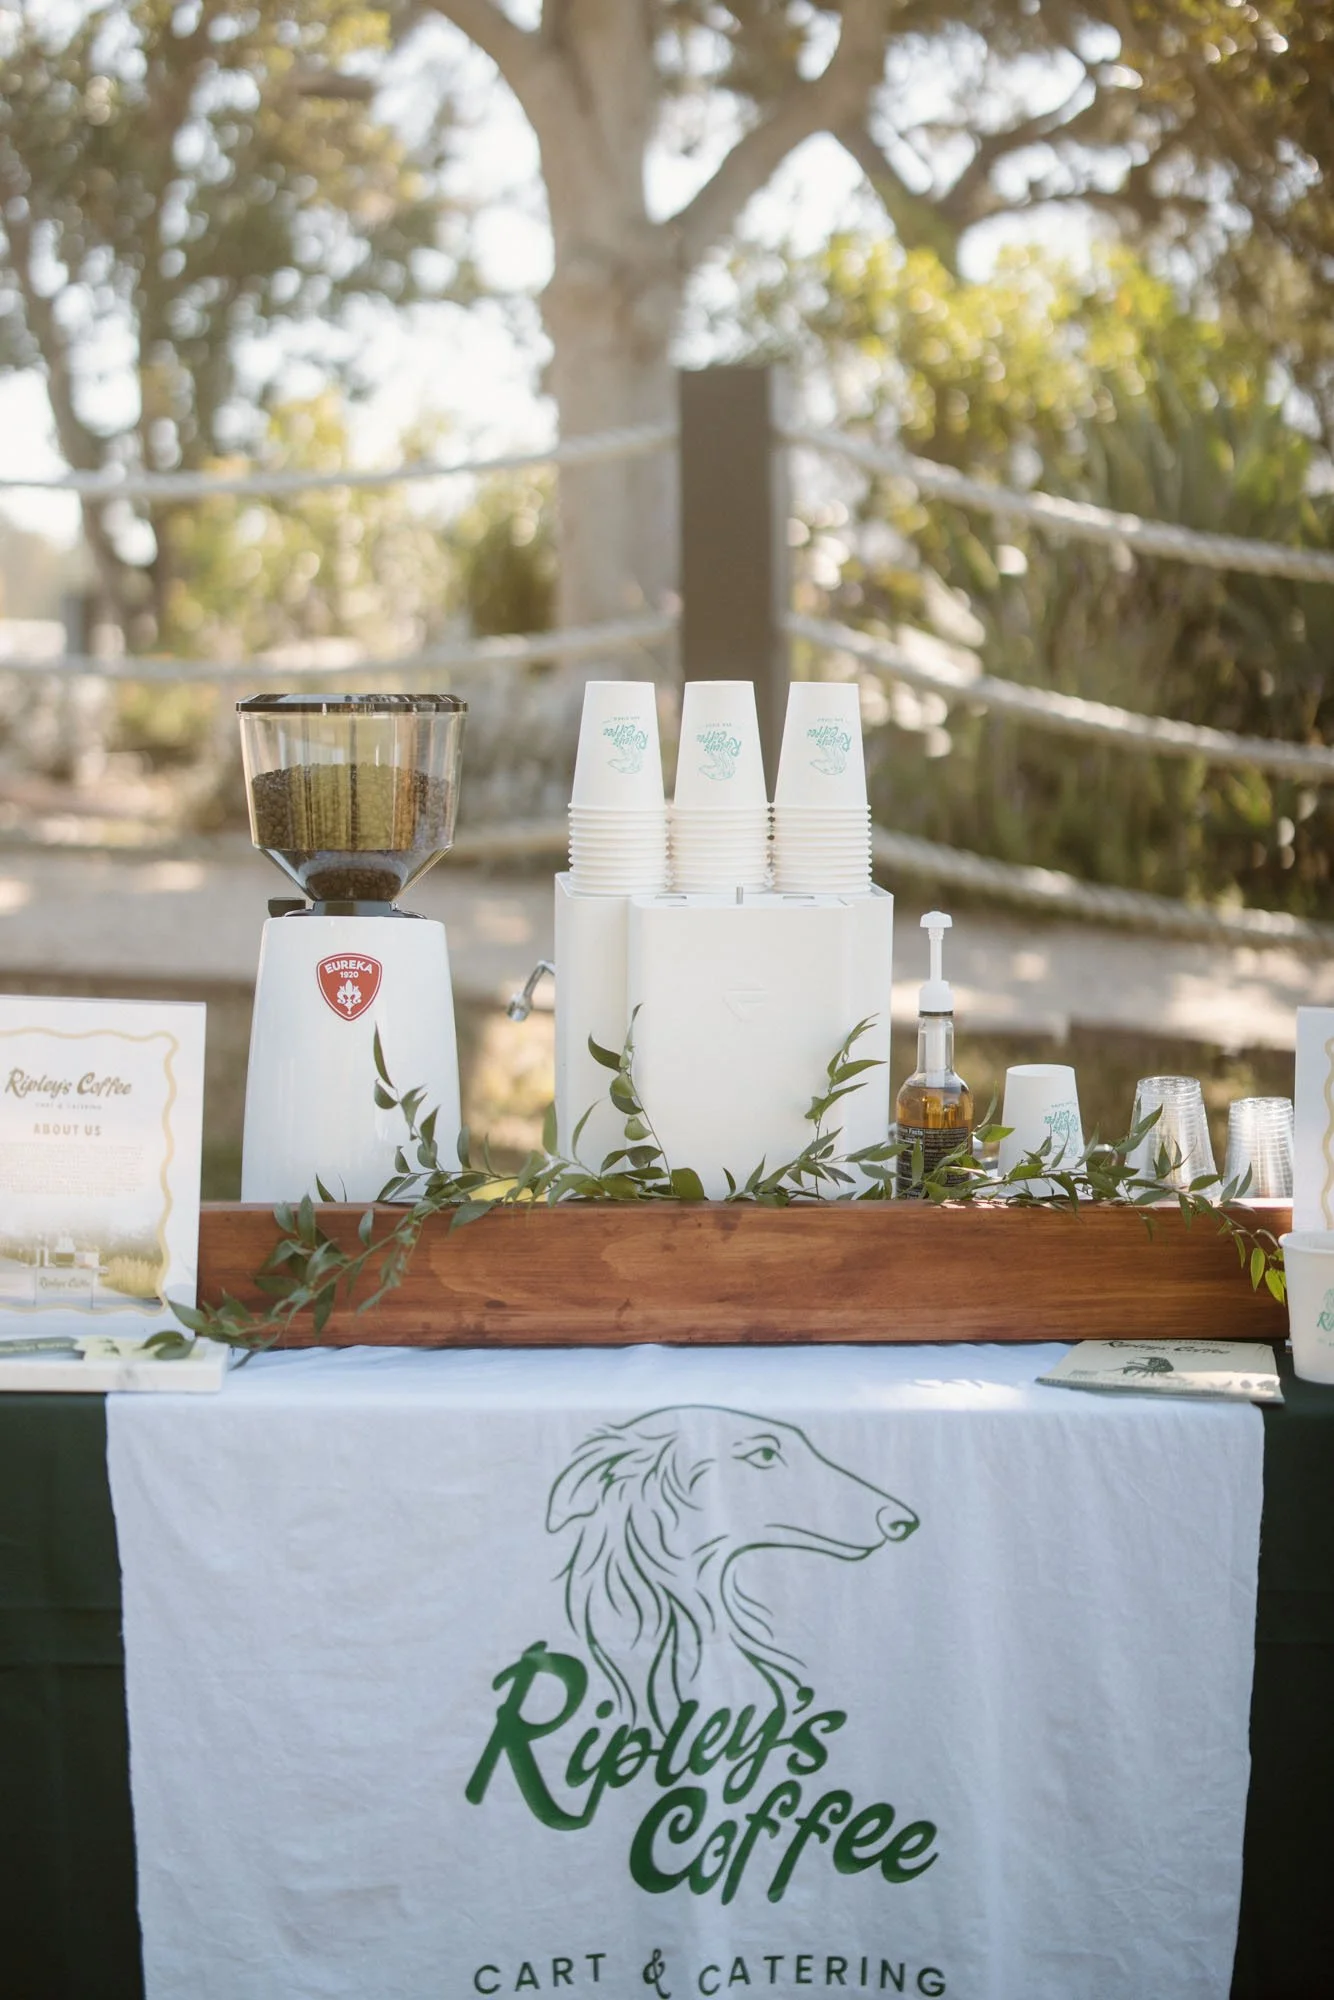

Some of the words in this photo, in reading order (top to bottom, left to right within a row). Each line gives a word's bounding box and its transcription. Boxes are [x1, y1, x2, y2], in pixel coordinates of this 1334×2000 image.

[603, 724, 636, 739] Coffee
[695, 730, 727, 745] Coffee
[806, 725, 839, 740] Coffee
[612, 730, 649, 751] Ripley's
[324, 959, 373, 974] EUREKA
[339, 971, 359, 979] 1920
[4, 1066, 73, 1099] Ripley's
[76, 1071, 133, 1097] Coffee
[33, 1122, 80, 1136] ABOUT
[84, 1123, 103, 1137] US
[1172, 1344, 1232, 1355] Coffee
[464, 1640, 847, 1832] Ripley's
[628, 1779, 939, 1906] Coffee
[473, 1953, 608, 1995] CART
[642, 1948, 672, 2000] &
[698, 1954, 946, 1998] CATERING
